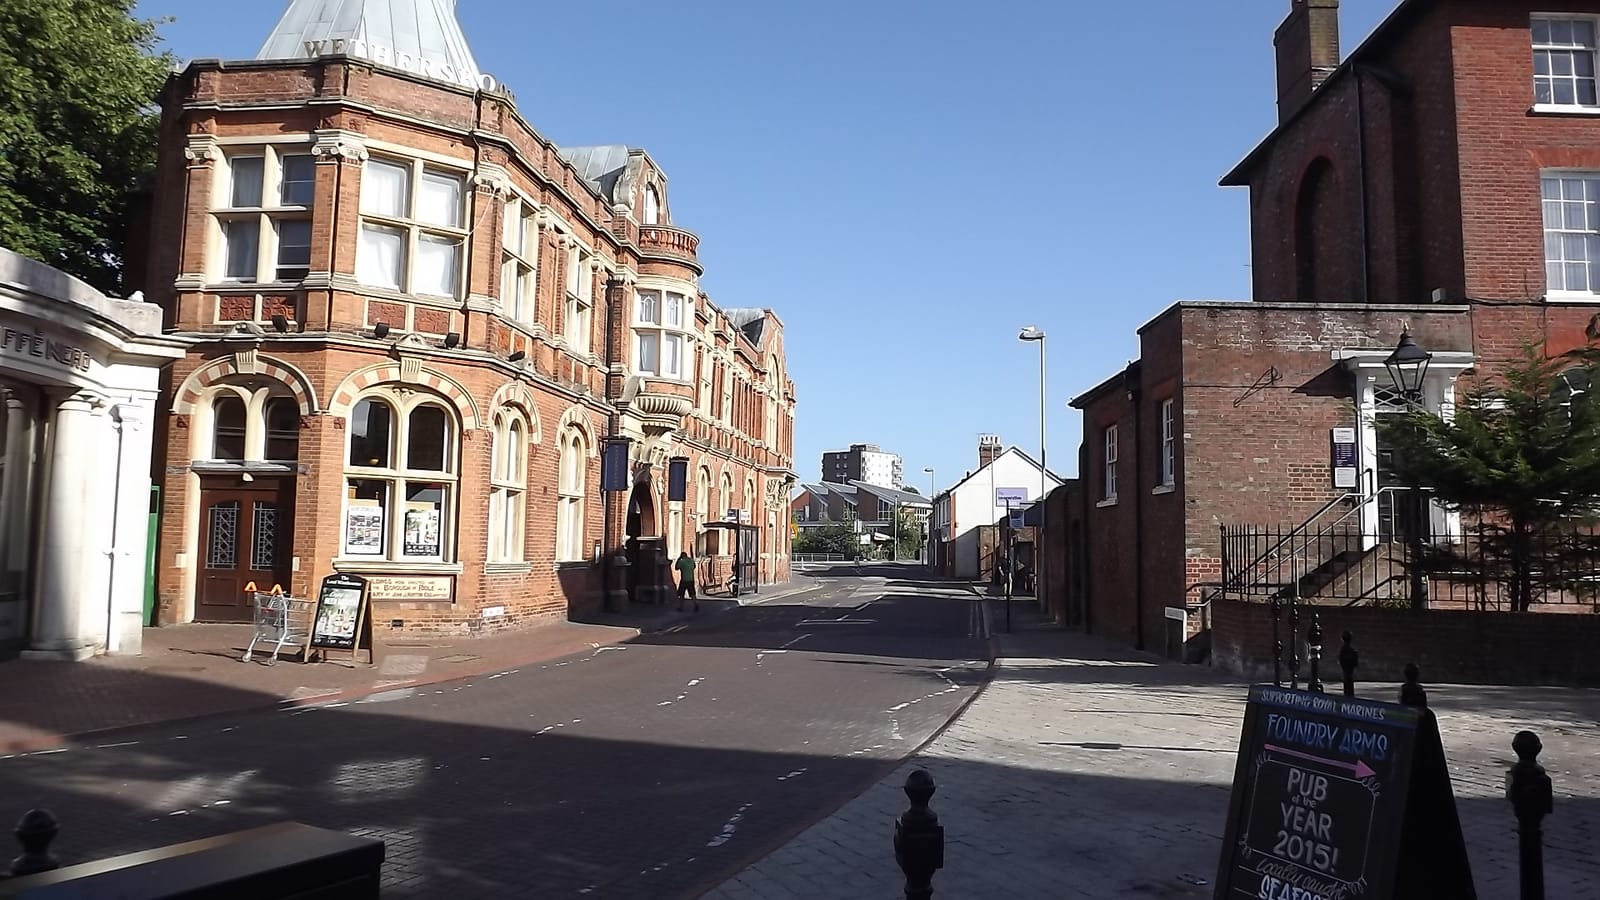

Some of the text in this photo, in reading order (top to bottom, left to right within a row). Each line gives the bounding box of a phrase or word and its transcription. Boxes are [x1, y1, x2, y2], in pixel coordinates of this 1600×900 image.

[1261, 689, 1386, 721] SUPPORTING ROYAL MARINES
[1265, 713, 1389, 761] FOUNDRY ARMS
[1286, 768, 1329, 800] PUB
[1302, 796, 1317, 809] the
[1280, 802, 1333, 841] YEAR
[1272, 830, 1339, 873] 2015!
[1258, 874, 1322, 900] SEAF
